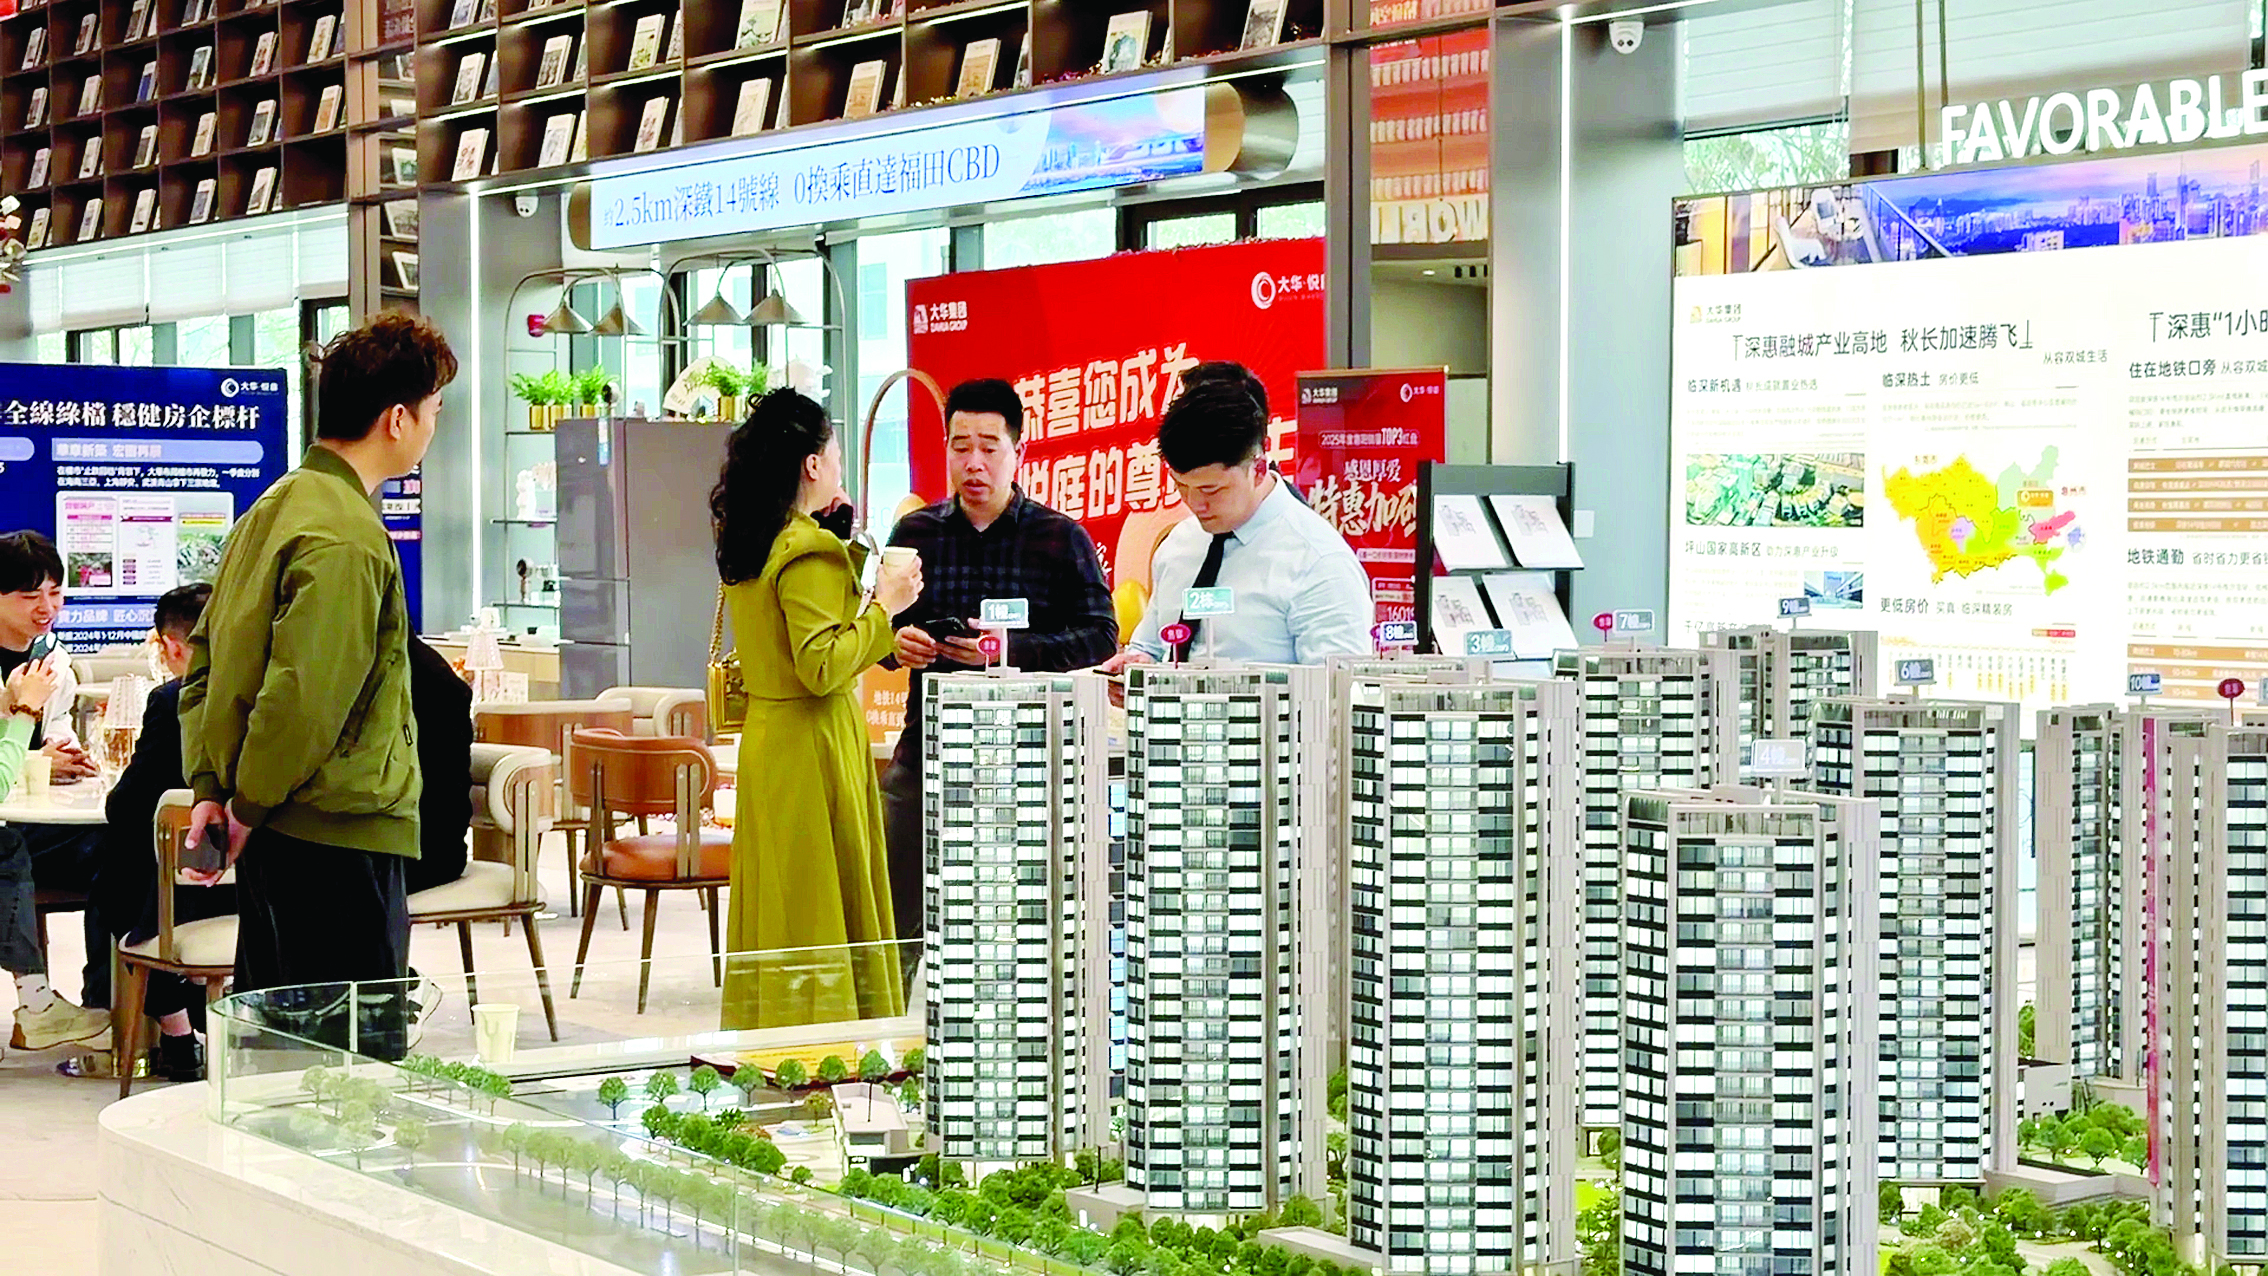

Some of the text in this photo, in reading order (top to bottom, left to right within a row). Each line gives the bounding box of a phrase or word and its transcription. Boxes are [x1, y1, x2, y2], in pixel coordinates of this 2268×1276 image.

[2129, 359, 2216, 379] 住在地铁口旁
[1882, 371, 1930, 388] 临深热土
[2127, 547, 2184, 565] 地铁通勤
